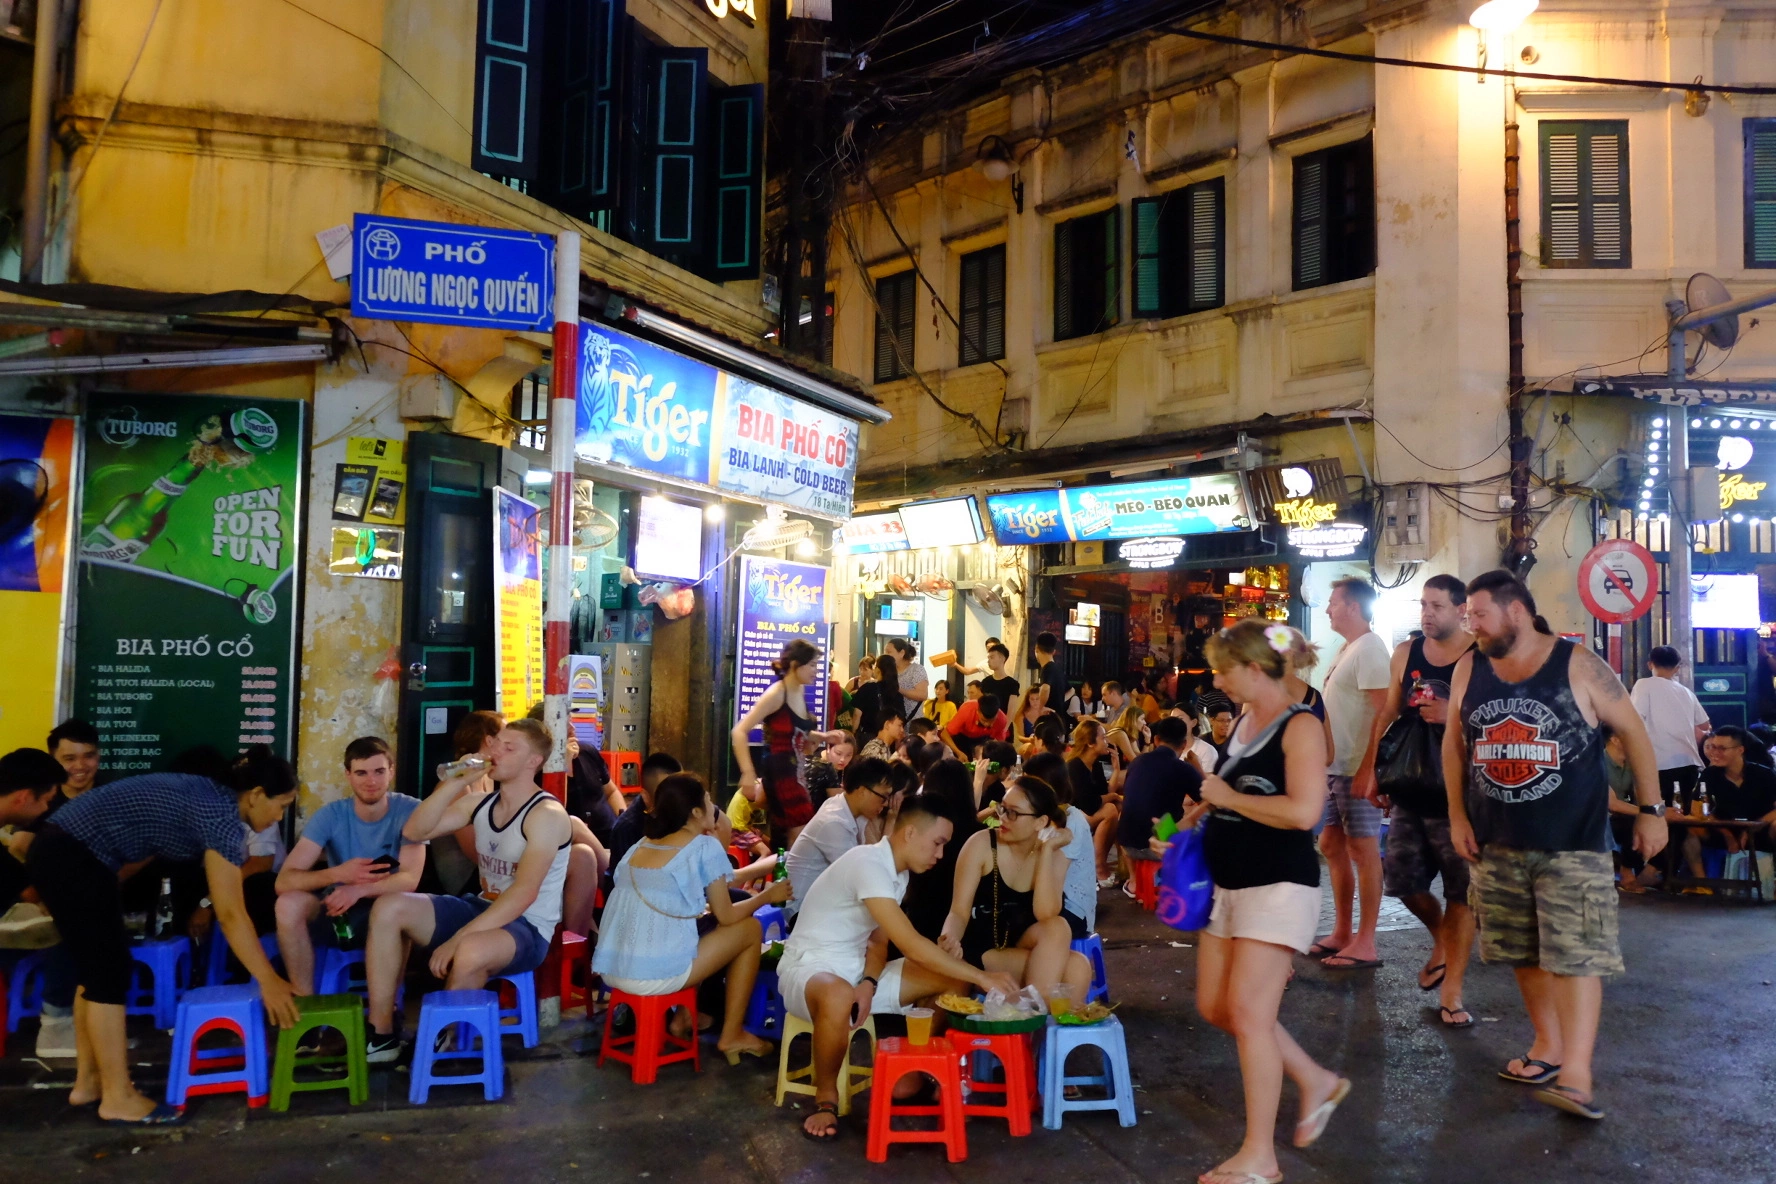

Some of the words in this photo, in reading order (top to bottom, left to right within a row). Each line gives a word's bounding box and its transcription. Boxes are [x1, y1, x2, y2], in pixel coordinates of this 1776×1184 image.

[425, 240, 488, 265] PHỐ
[367, 265, 427, 305] LƯƠNG
[431, 272, 479, 315] NGỌC
[483, 271, 539, 316] QUYẾN
[609, 367, 708, 462] Tiger
[107, 418, 178, 438] TUBORG
[243, 418, 275, 435] TUBORG
[737, 403, 777, 447] BIA
[780, 418, 823, 460] PHỐ
[824, 427, 849, 469] CỔ
[671, 445, 690, 457] 1932
[729, 447, 751, 469] BIA
[753, 453, 785, 479] LẠNH
[793, 467, 820, 489] COLD
[821, 473, 848, 497] BEER
[213, 484, 282, 513] OPEN
[814, 496, 822, 508] 18
[1718, 473, 1767, 511] ger
[213, 510, 282, 538] FOR
[1002, 503, 1058, 538] Tiger
[1274, 498, 1337, 530] Tiger
[881, 521, 903, 533] 23
[1288, 528, 1368, 546] STRONGBOW
[212, 535, 282, 571] FUN
[1119, 540, 1186, 558] STRONGBOW
[763, 574, 822, 614] Tiger
[757, 621, 776, 631] BIA
[778, 621, 800, 633] PHỐ
[116, 638, 156, 655] BIA
[161, 634, 211, 656] PHỐ
[217, 633, 254, 657] CỔ
[98, 665, 114, 673] BIA
[115, 665, 151, 673] HALIDA
[97, 679, 113, 687] BIA
[140, 679, 175, 687] HALIDA
[177, 679, 215, 688] (LOCAL)
[114, 693, 153, 701] TUBORG
[1469, 698, 1560, 731] PHUKET
[112, 734, 160, 742] HEINEKEN
[1491, 722, 1529, 741] MOTOR
[98, 762, 110, 770] IA
[1490, 763, 1529, 779] CYCLES
[1474, 769, 1563, 803] THAILAND
